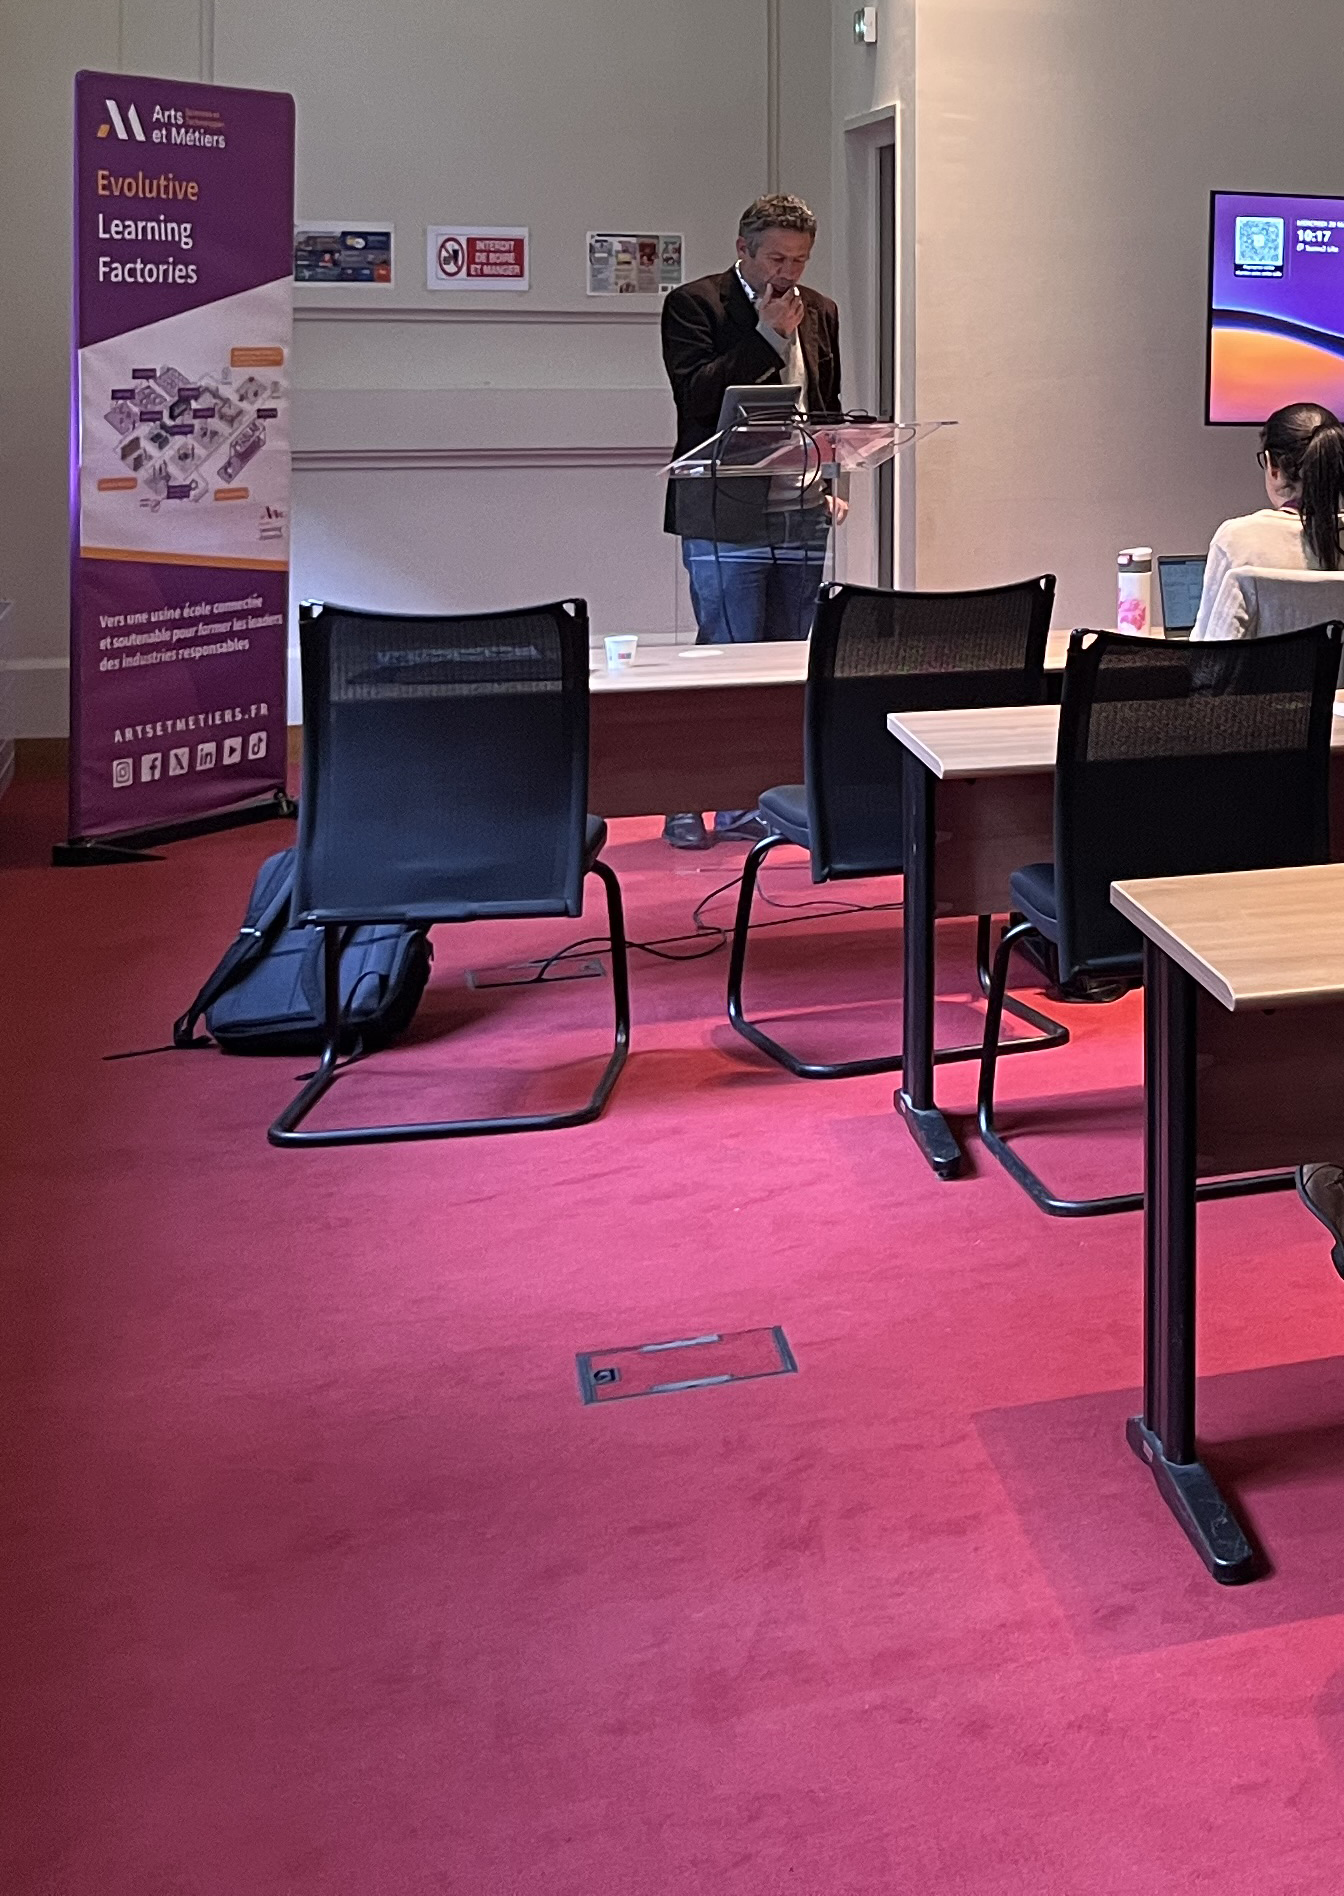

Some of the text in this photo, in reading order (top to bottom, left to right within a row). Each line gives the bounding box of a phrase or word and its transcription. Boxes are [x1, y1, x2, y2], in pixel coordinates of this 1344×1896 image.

[152, 104, 184, 125] Arts
[152, 126, 226, 149] et Métiers
[97, 169, 199, 201] Evolutive
[98, 213, 193, 249] Learning
[1297, 229, 1332, 242] 10:17
[98, 257, 198, 284] Factories
[100, 615, 125, 629] Vers
[127, 612, 149, 625] une
[150, 606, 181, 622] usine
[183, 602, 212, 618] école
[113, 627, 171, 648] soutenable
[173, 626, 198, 644] pour
[100, 656, 120, 672] des
[114, 703, 269, 744] ARTSETMETIERS.FR
